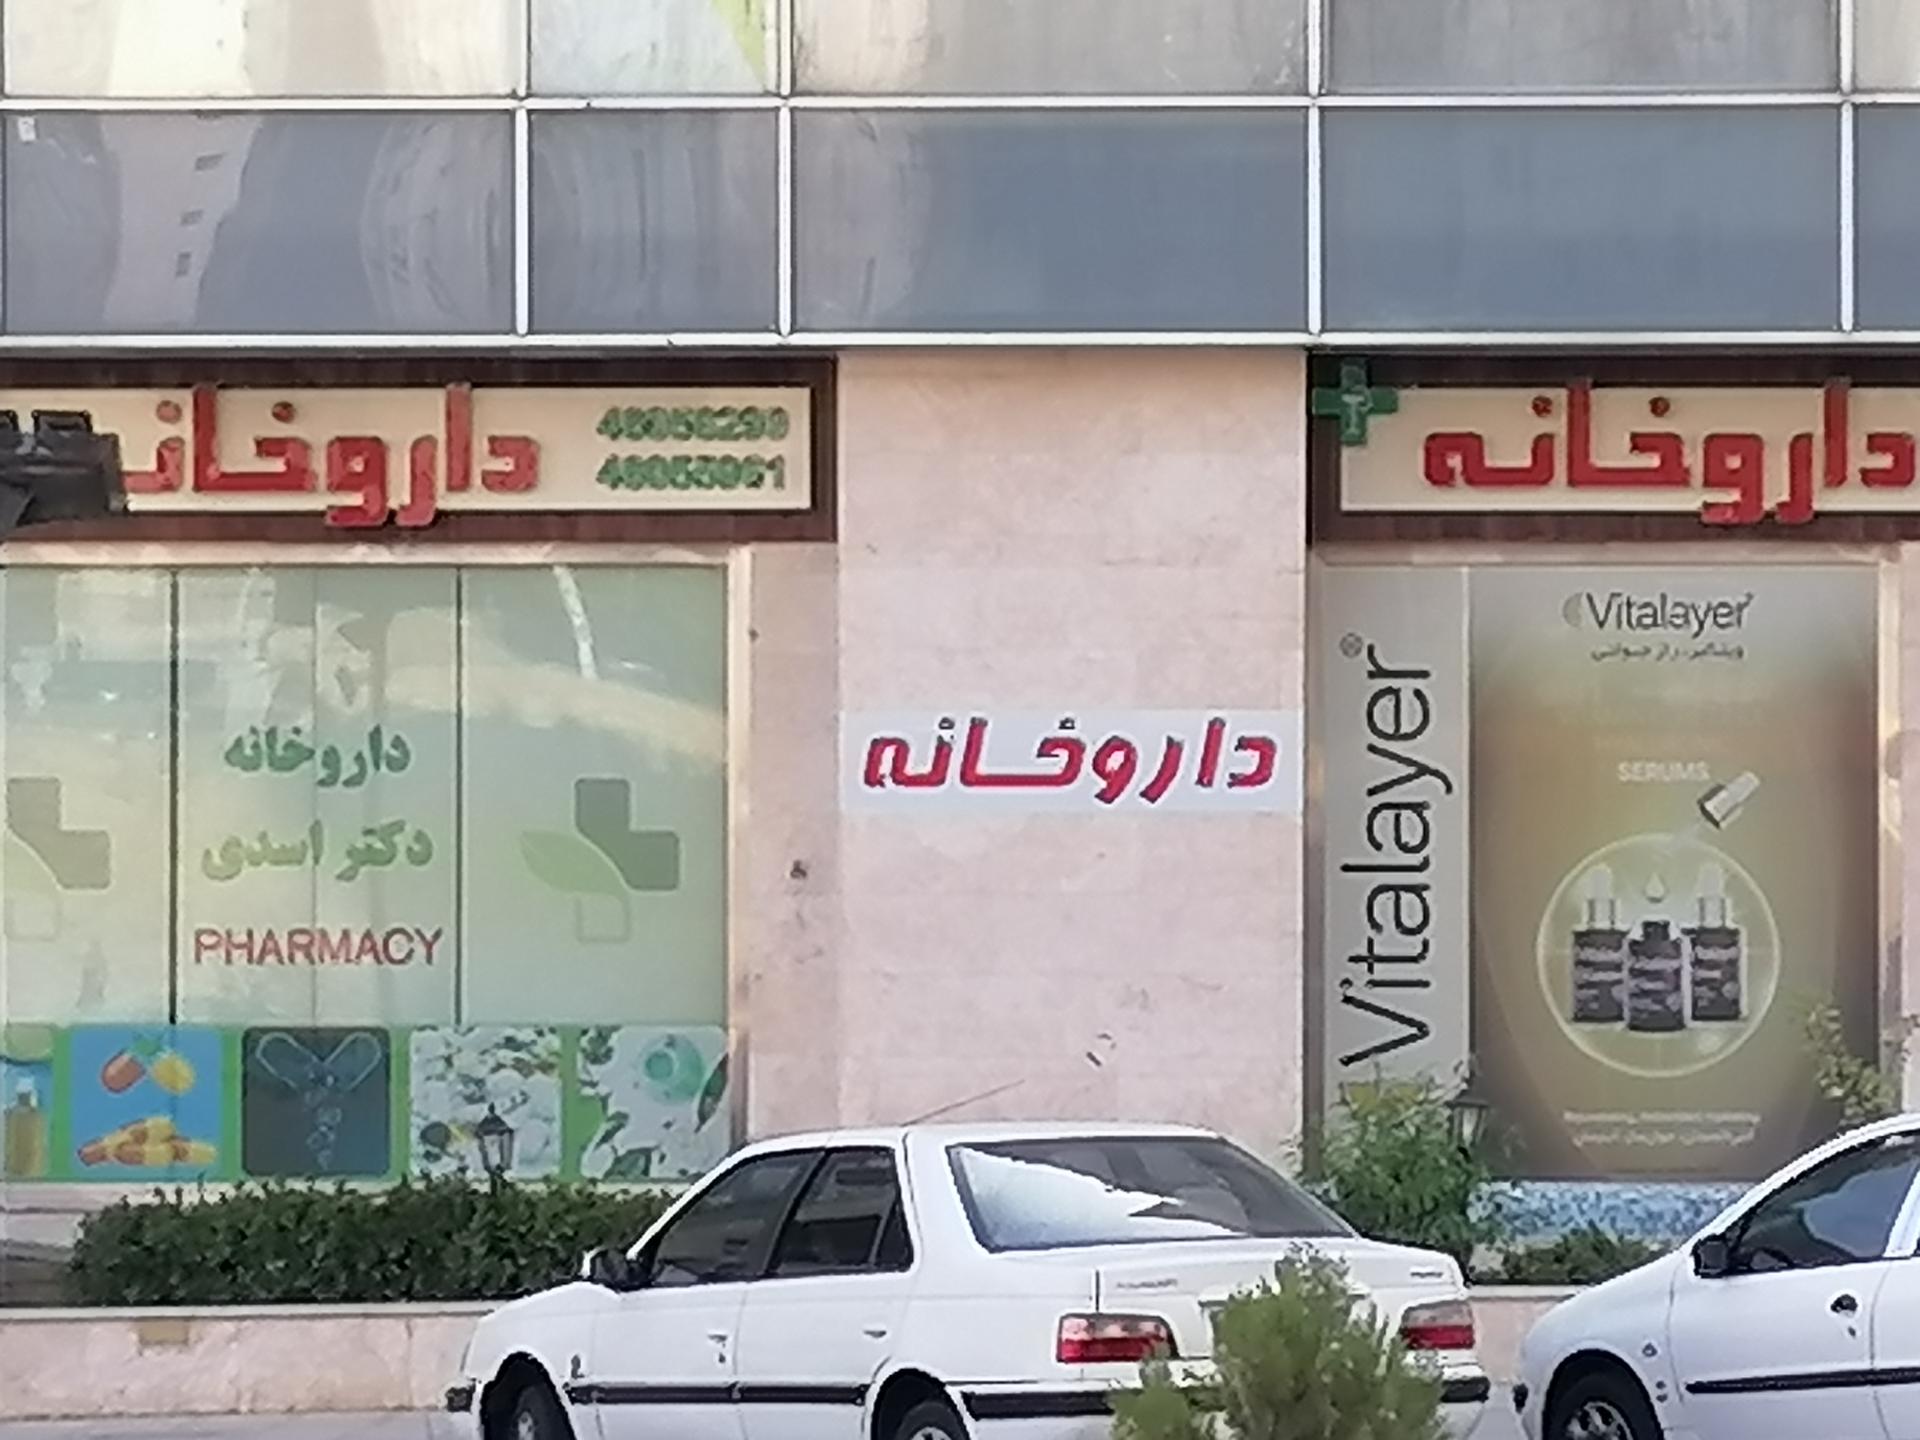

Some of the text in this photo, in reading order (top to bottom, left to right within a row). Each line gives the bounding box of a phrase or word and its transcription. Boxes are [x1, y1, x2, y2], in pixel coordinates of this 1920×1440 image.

[121, 382, 539, 527] داروخان
[1423, 377, 1916, 524] داروخانه
[1586, 592, 1754, 639] Vitalayer
[224, 723, 412, 788] داروخانه
[864, 716, 1277, 804] داروخانه
[1618, 760, 1711, 782] SERUMS
[335, 819, 433, 882] دکتر
[1340, 643, 1454, 1067] Vitalayer
[194, 927, 443, 966] PHARMACY
